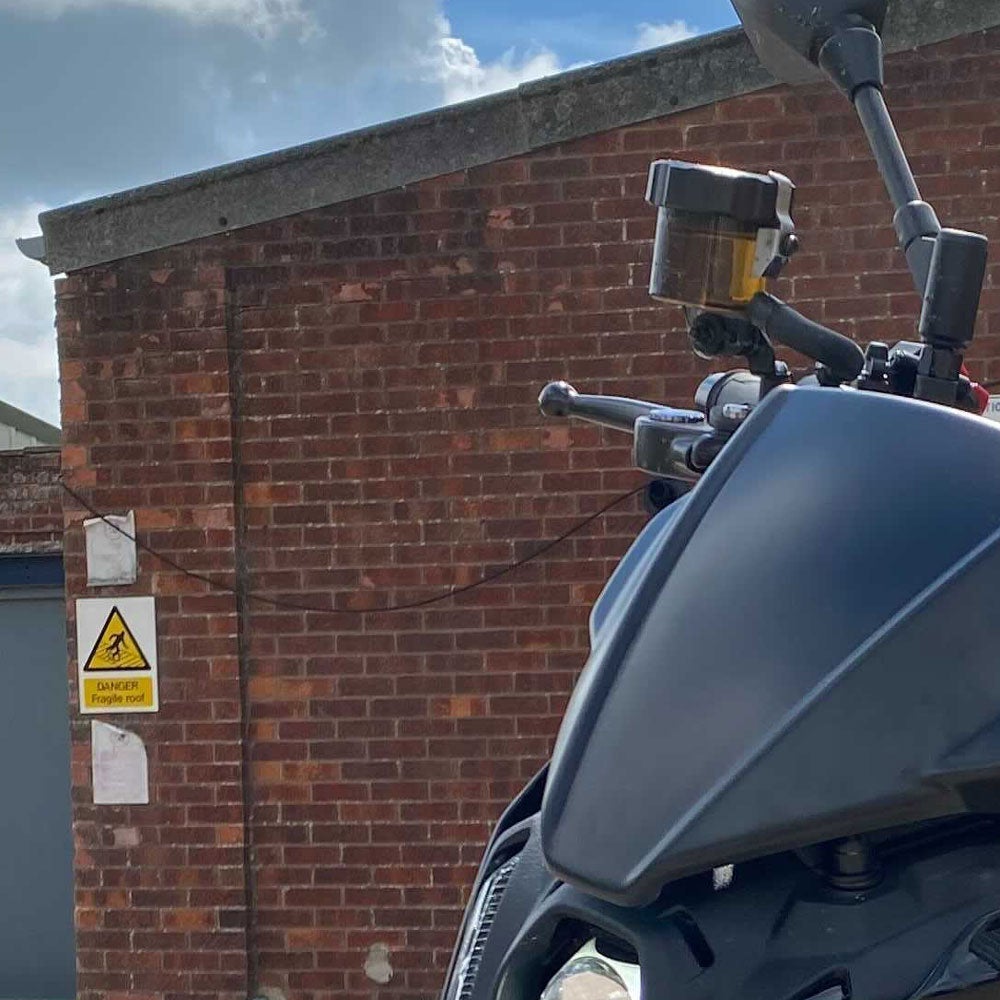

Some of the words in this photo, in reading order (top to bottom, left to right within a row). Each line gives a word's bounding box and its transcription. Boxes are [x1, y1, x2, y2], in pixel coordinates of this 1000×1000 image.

[97, 681, 139, 691] DANGER
[91, 693, 122, 704] Fragile
[126, 693, 145, 703] roof
